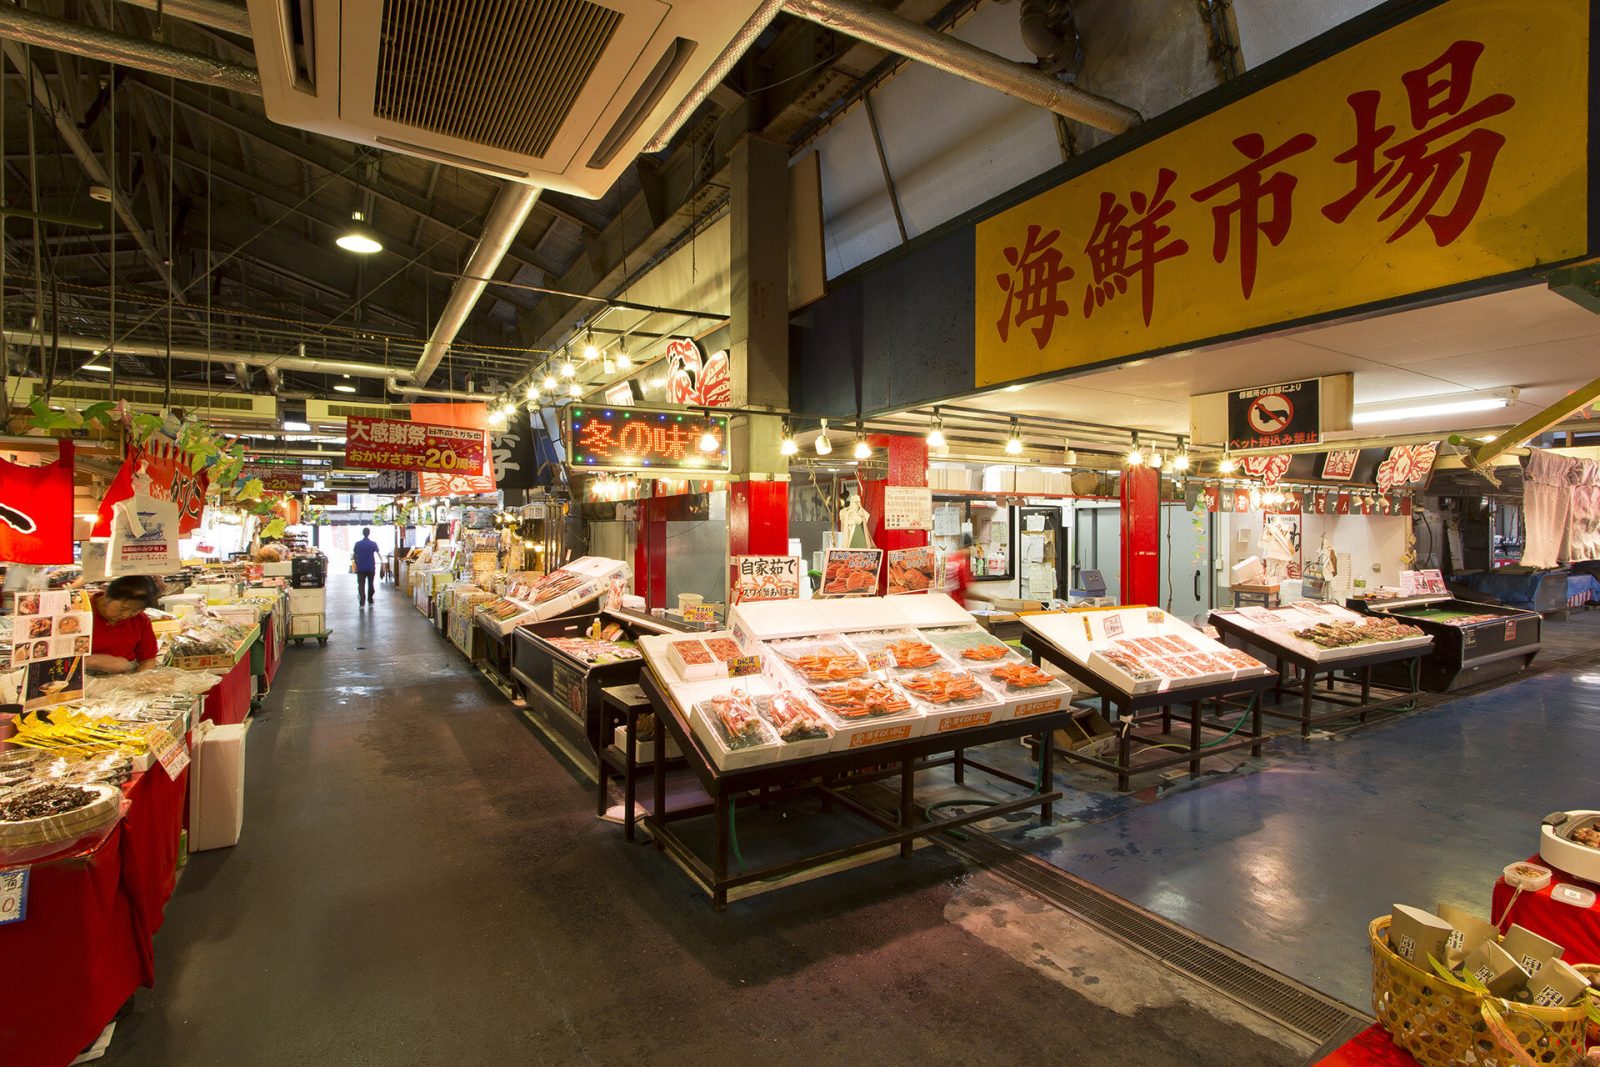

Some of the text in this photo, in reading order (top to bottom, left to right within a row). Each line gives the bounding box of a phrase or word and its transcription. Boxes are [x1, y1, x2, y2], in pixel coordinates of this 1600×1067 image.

[995, 40, 1515, 350] 海鮮市場
[350, 420, 426, 446] 大感謝祭
[1229, 431, 1318, 448] ペット持込み禁止
[350, 448, 481, 470] おかげさまで20周年
[741, 558, 797, 576] 自家茹で
